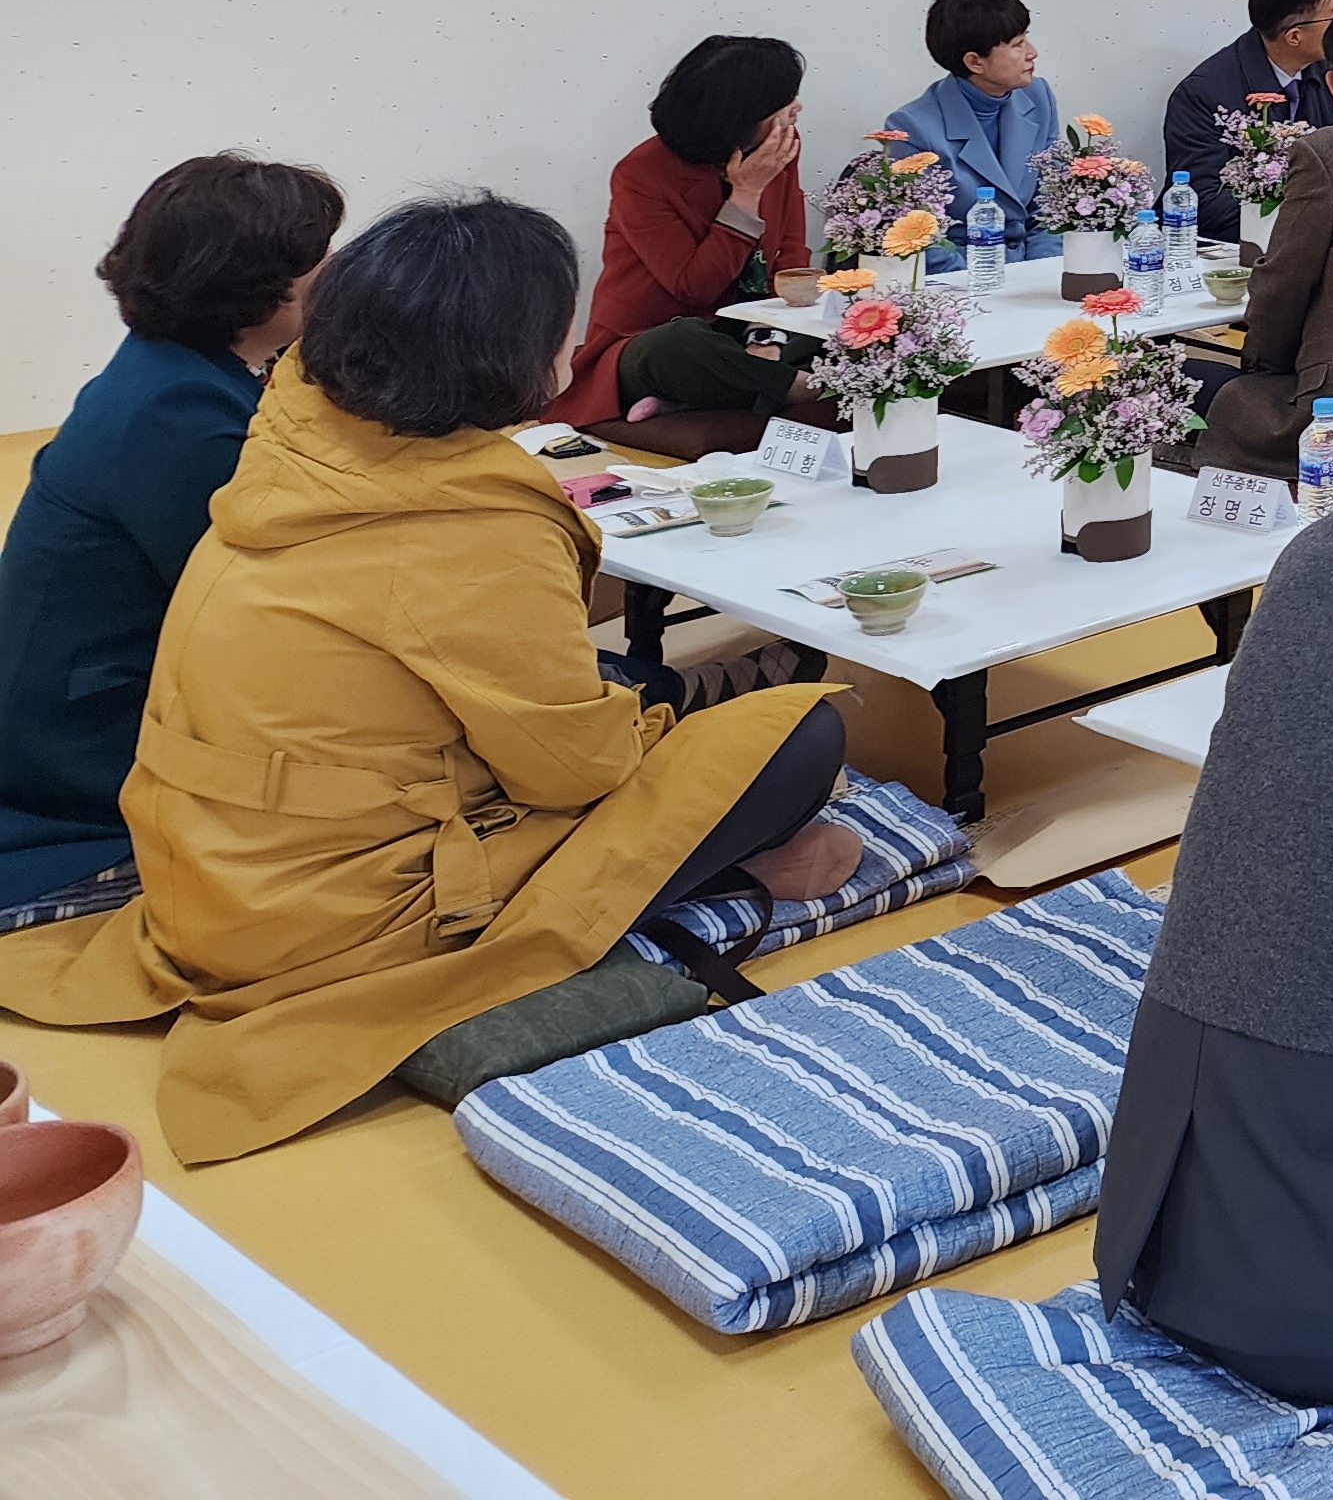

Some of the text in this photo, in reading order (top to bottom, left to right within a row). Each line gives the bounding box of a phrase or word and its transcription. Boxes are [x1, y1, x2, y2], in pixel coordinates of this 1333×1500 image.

[763, 445, 816, 474] 이미향
[1211, 472, 1268, 494] 선주중학교
[1199, 495, 1267, 526] 장명순
